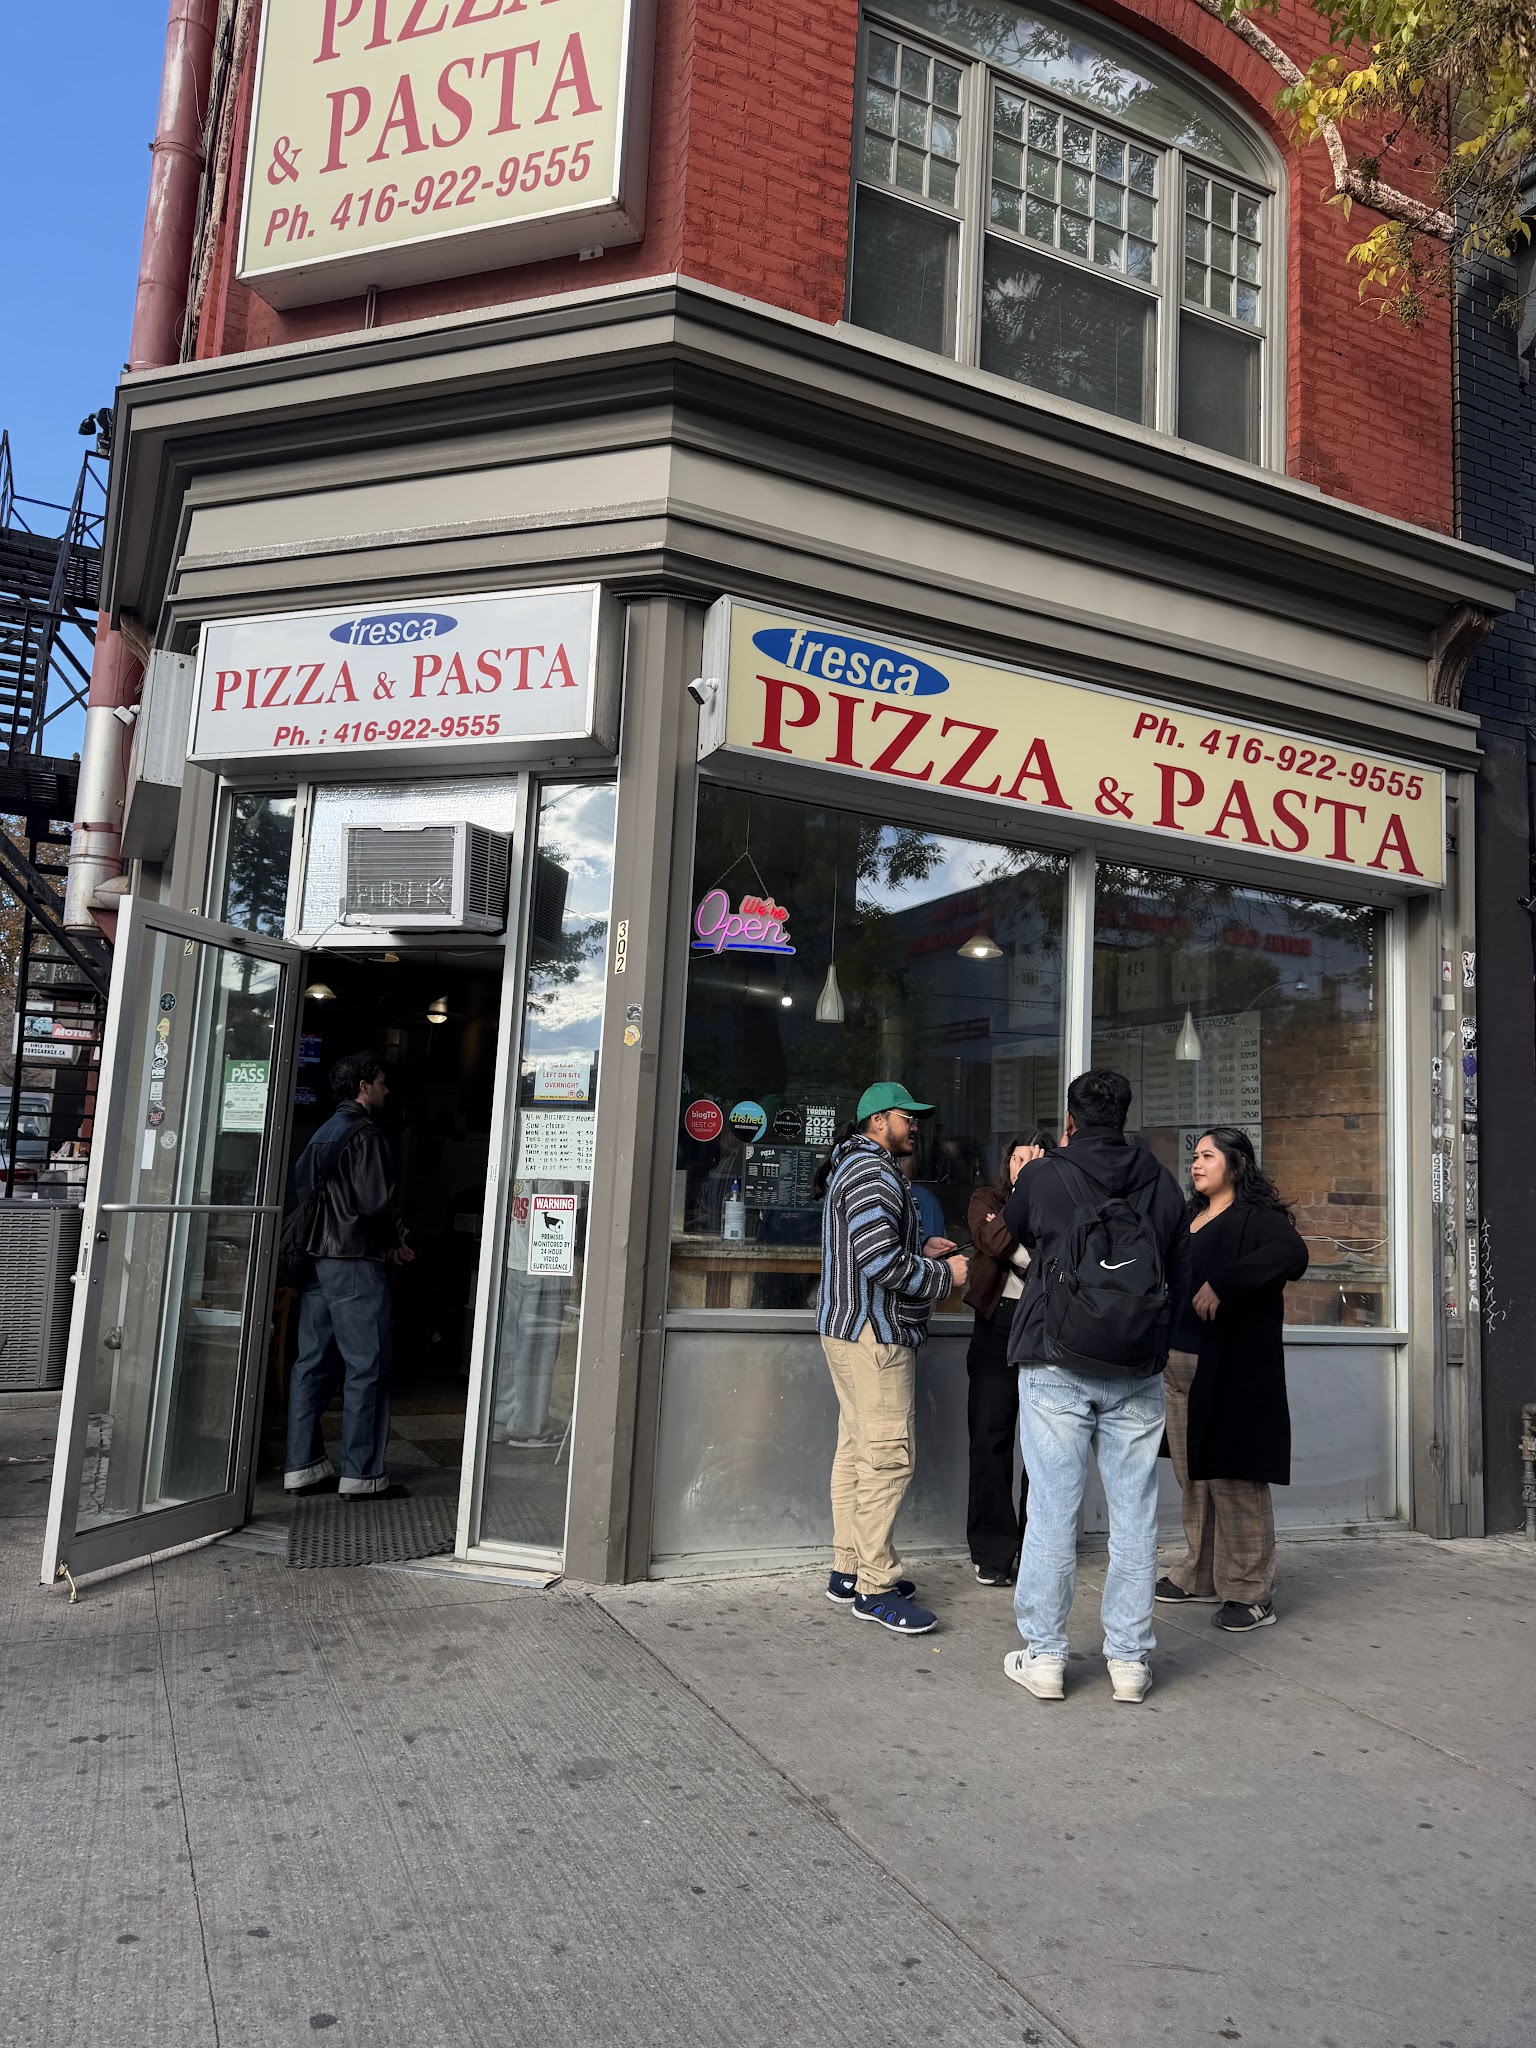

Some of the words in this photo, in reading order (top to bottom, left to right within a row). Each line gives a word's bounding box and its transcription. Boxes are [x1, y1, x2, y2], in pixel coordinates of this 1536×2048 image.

[266, 135, 303, 186] &
[318, 31, 603, 175] PASTA
[263, 207, 316, 248] Ph.
[329, 139, 595, 231] 416-922-9555
[348, 616, 438, 645] fresca
[784, 628, 920, 697] fresca
[211, 660, 360, 712] PIZZA
[372, 671, 397, 700] &
[409, 642, 579, 699] PASTA
[272, 724, 310, 747] Ph.
[333, 713, 501, 744] 416-922-9555
[1131, 711, 1186, 749] Ph.
[1199, 728, 1425, 801] 416-922-9555
[751, 674, 1074, 811] PIZZA
[1093, 775, 1135, 820] &
[1152, 762, 1425, 878] PASTA
[741, 897, 787, 921] We're
[697, 890, 788, 953] Open
[616, 922, 627, 973] 302
[54, 1027, 93, 1039] MOTUL
[1163, 1019, 1205, 1035] GOUET
[230, 1067, 265, 1083] PASS
[557, 1071, 567, 1079] ON
[543, 1113, 575, 1121] BUSINESS
[691, 1110, 718, 1120] blogTO
[730, 1112, 765, 1125] dished
[806, 1108, 836, 1117] TORONTO
[805, 1117, 836, 1128] 2024
[805, 1126, 836, 1137] BEST
[804, 1137, 835, 1146] PIZZAS
[1433, 1156, 1442, 1202] DARENO
[535, 1198, 574, 1210] WARNING
[533, 1240, 563, 1248] MONITORED
[533, 1263, 568, 1271] SURVEILLANCE
